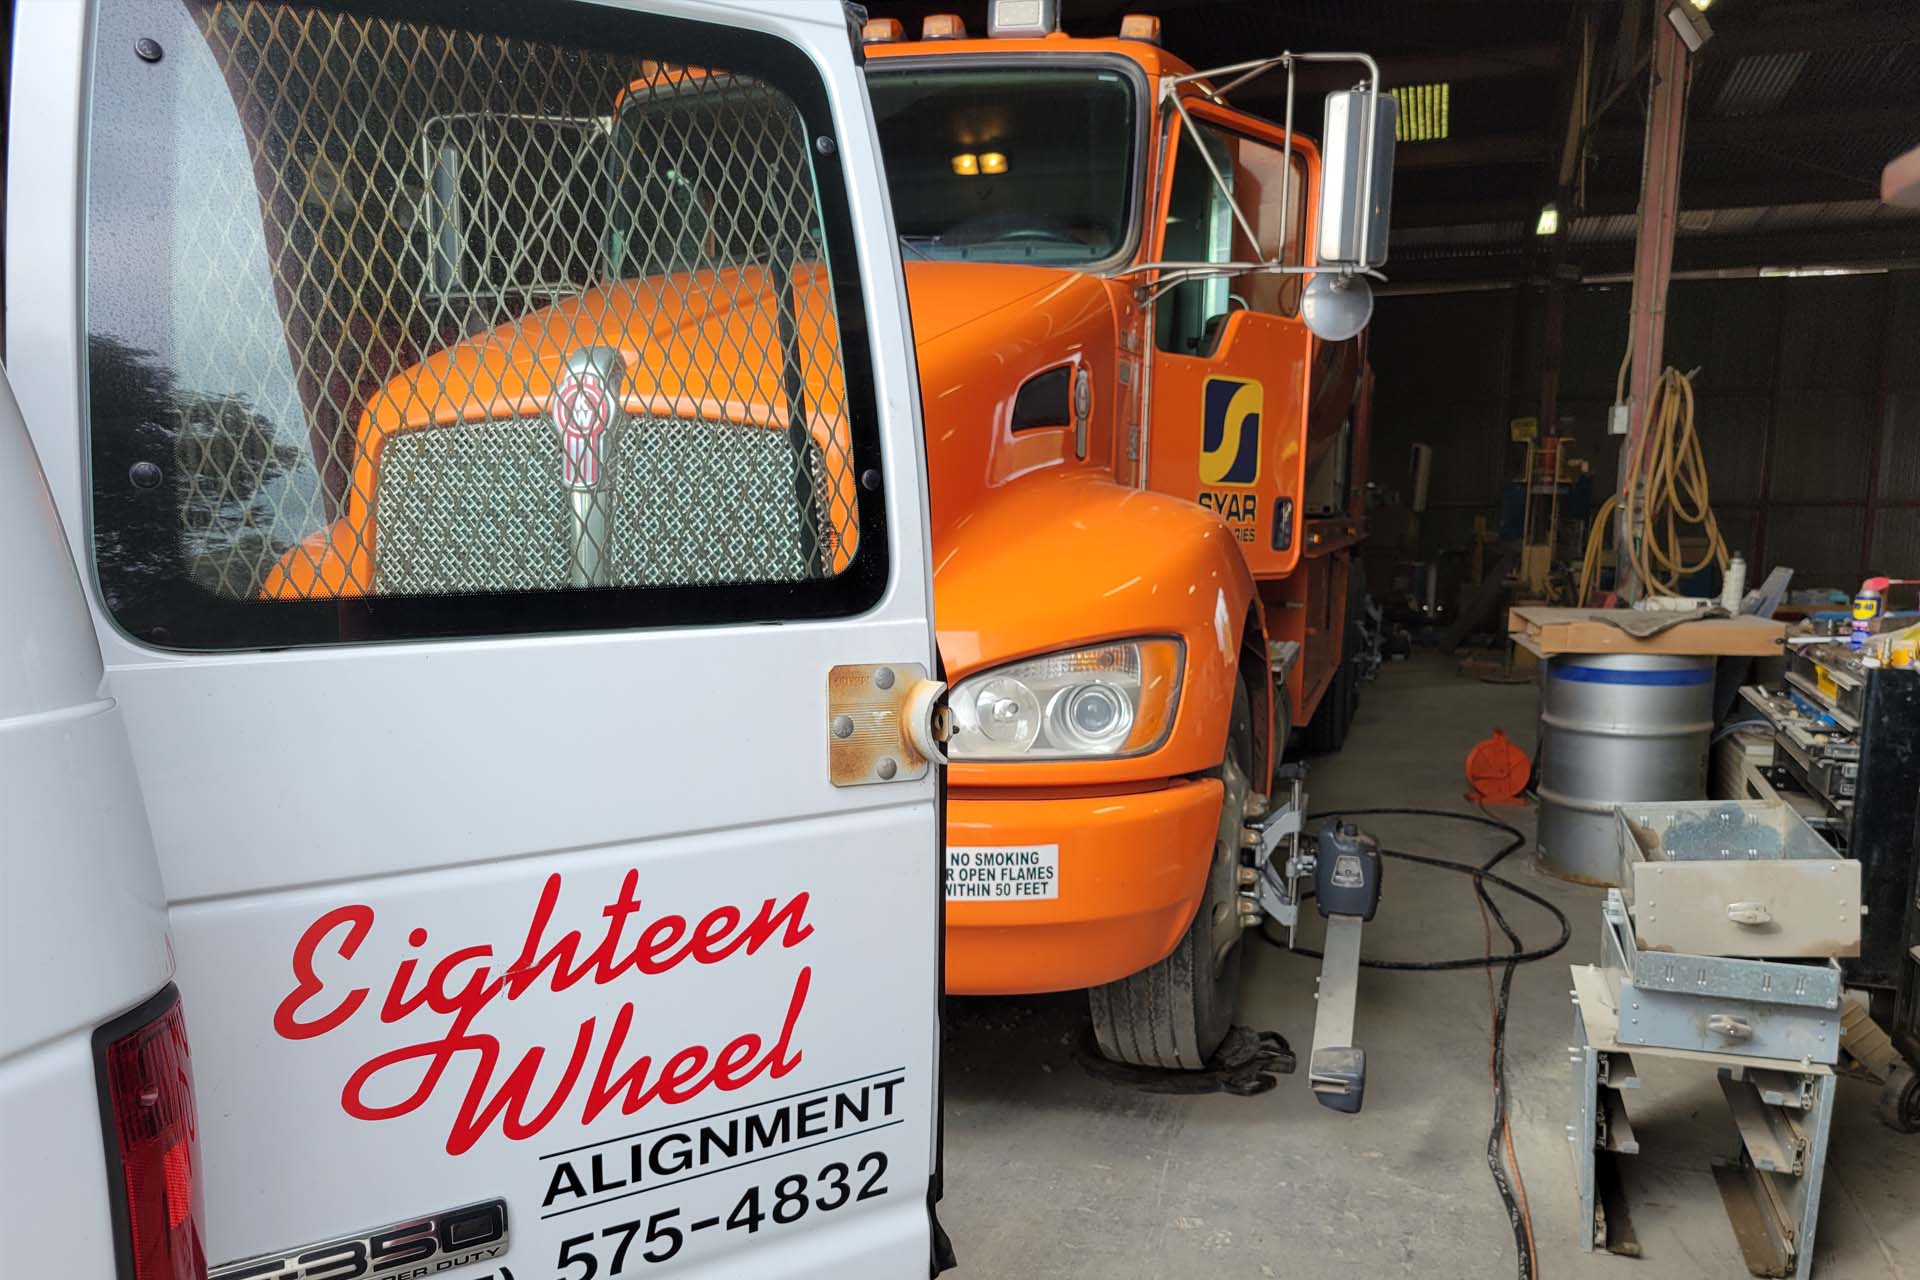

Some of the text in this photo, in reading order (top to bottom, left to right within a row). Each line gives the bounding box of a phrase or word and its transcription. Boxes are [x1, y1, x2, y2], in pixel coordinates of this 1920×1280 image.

[1198, 492, 1257, 522] SYAR
[950, 851, 1040, 867] NO SMOKING
[959, 868, 996, 882] OPEN
[1000, 866, 1054, 881] FLAMES
[995, 882, 1012, 896] 50
[1016, 881, 1049, 896] FEET
[273, 868, 814, 1118] Eighteen
[341, 966, 812, 1156] Wheel
[541, 1077, 905, 1207] ALIGNMENT
[208, 1202, 505, 1280] -350
[557, 1151, 889, 1280] 575-4832
[436, 1246, 501, 1272] DUTY
